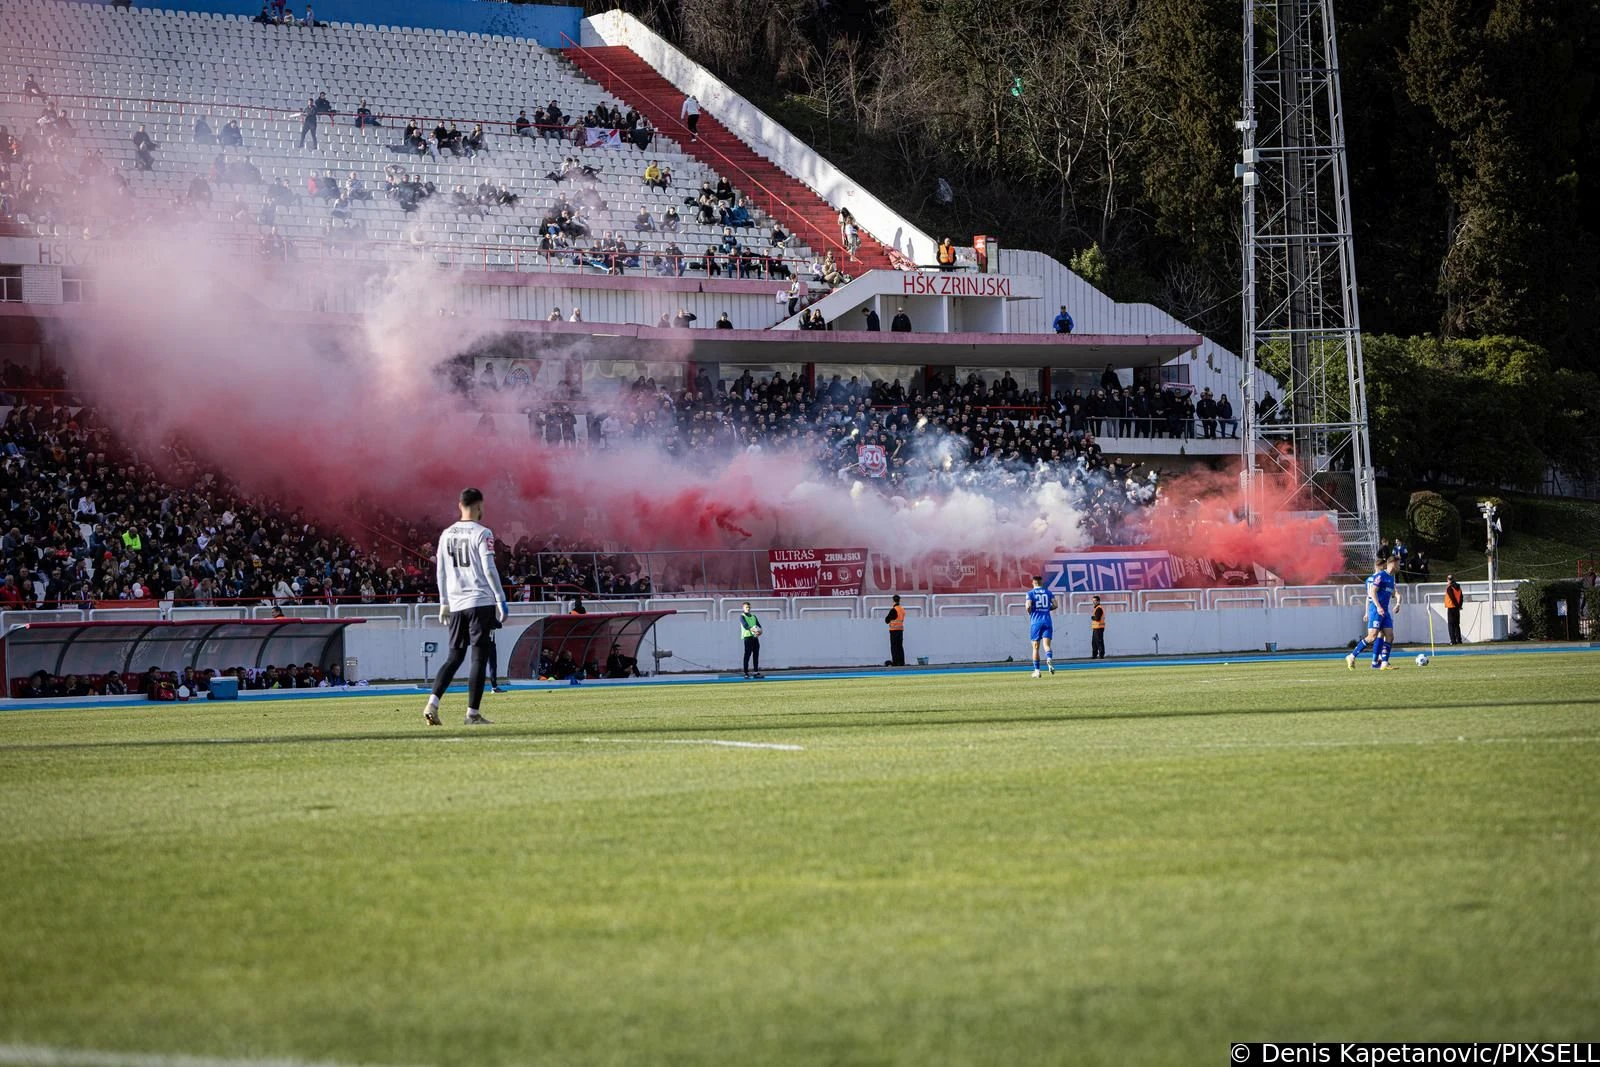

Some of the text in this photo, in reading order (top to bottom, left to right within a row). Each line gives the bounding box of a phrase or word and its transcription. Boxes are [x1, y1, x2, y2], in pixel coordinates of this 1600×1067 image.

[903, 272, 1011, 296] HŠK ZRINJSKI
[864, 451, 881, 465] 20
[447, 537, 471, 568] 40
[774, 549, 815, 561] ULTRAS
[824, 552, 861, 562] ZRINJSKI
[822, 571, 833, 581] 19
[1035, 593, 1049, 608] 20
